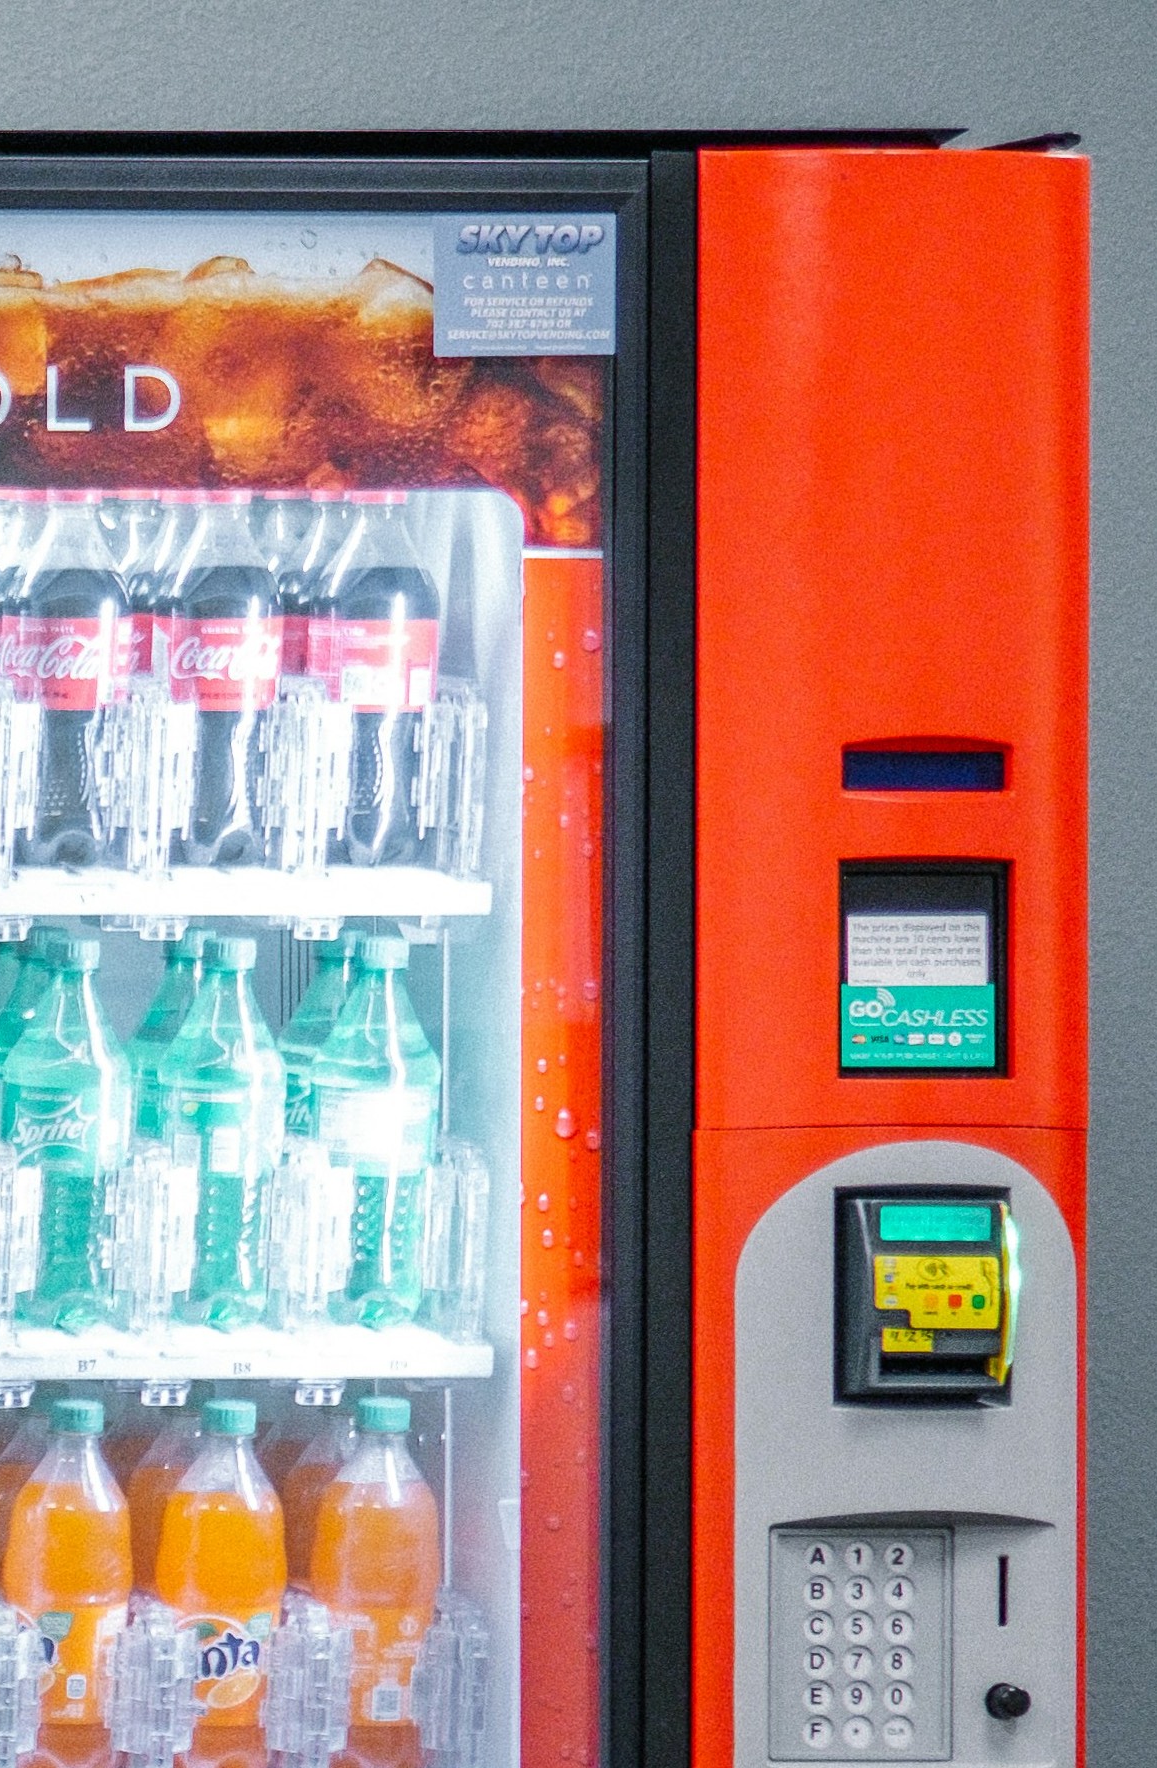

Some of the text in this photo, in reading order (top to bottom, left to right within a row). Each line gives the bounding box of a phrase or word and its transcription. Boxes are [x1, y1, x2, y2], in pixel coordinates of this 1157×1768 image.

[457, 225, 604, 254] SKY TOP
[463, 272, 589, 289] canteen
[464, 297, 593, 306] FOR SERVICE OR REFUNDS
[471, 308, 586, 317] PLEASE CONTACT US AT
[849, 1000, 988, 1027] GO CASHLESS
[18, 1117, 84, 1146] Sprite
[77, 1360, 96, 1373] B7
[810, 1548, 903, 1564] A 1 2
[810, 1583, 903, 1599] B 3 4
[810, 1618, 903, 1635] C 5 6
[202, 1633, 259, 1677] nta
[810, 1653, 903, 1669] D 7 8
[810, 1688, 903, 1704] E 9 0
[811, 1723, 822, 1739] F
